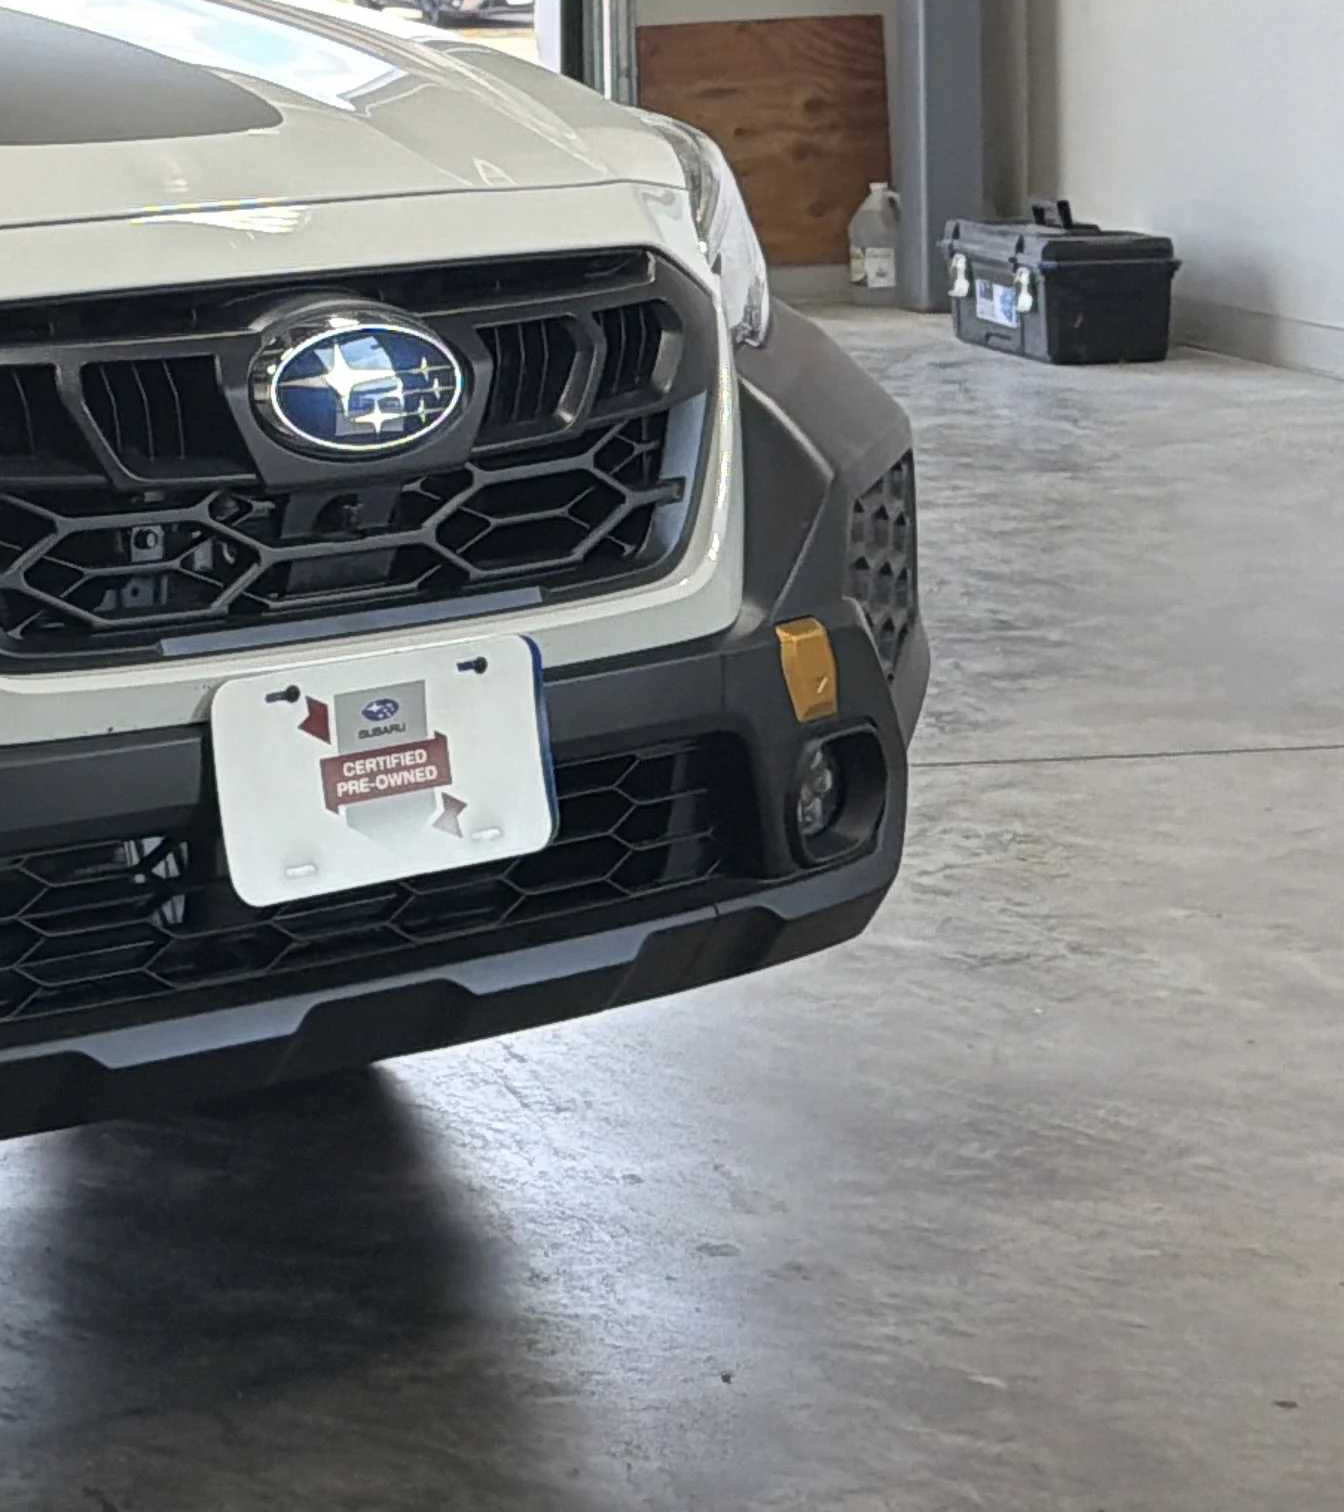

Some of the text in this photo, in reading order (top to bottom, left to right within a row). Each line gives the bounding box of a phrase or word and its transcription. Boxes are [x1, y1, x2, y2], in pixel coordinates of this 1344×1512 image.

[357, 722, 407, 740] SUBARU
[342, 748, 428, 777] CERTIFIED
[336, 764, 439, 798] PRE-OWNED
